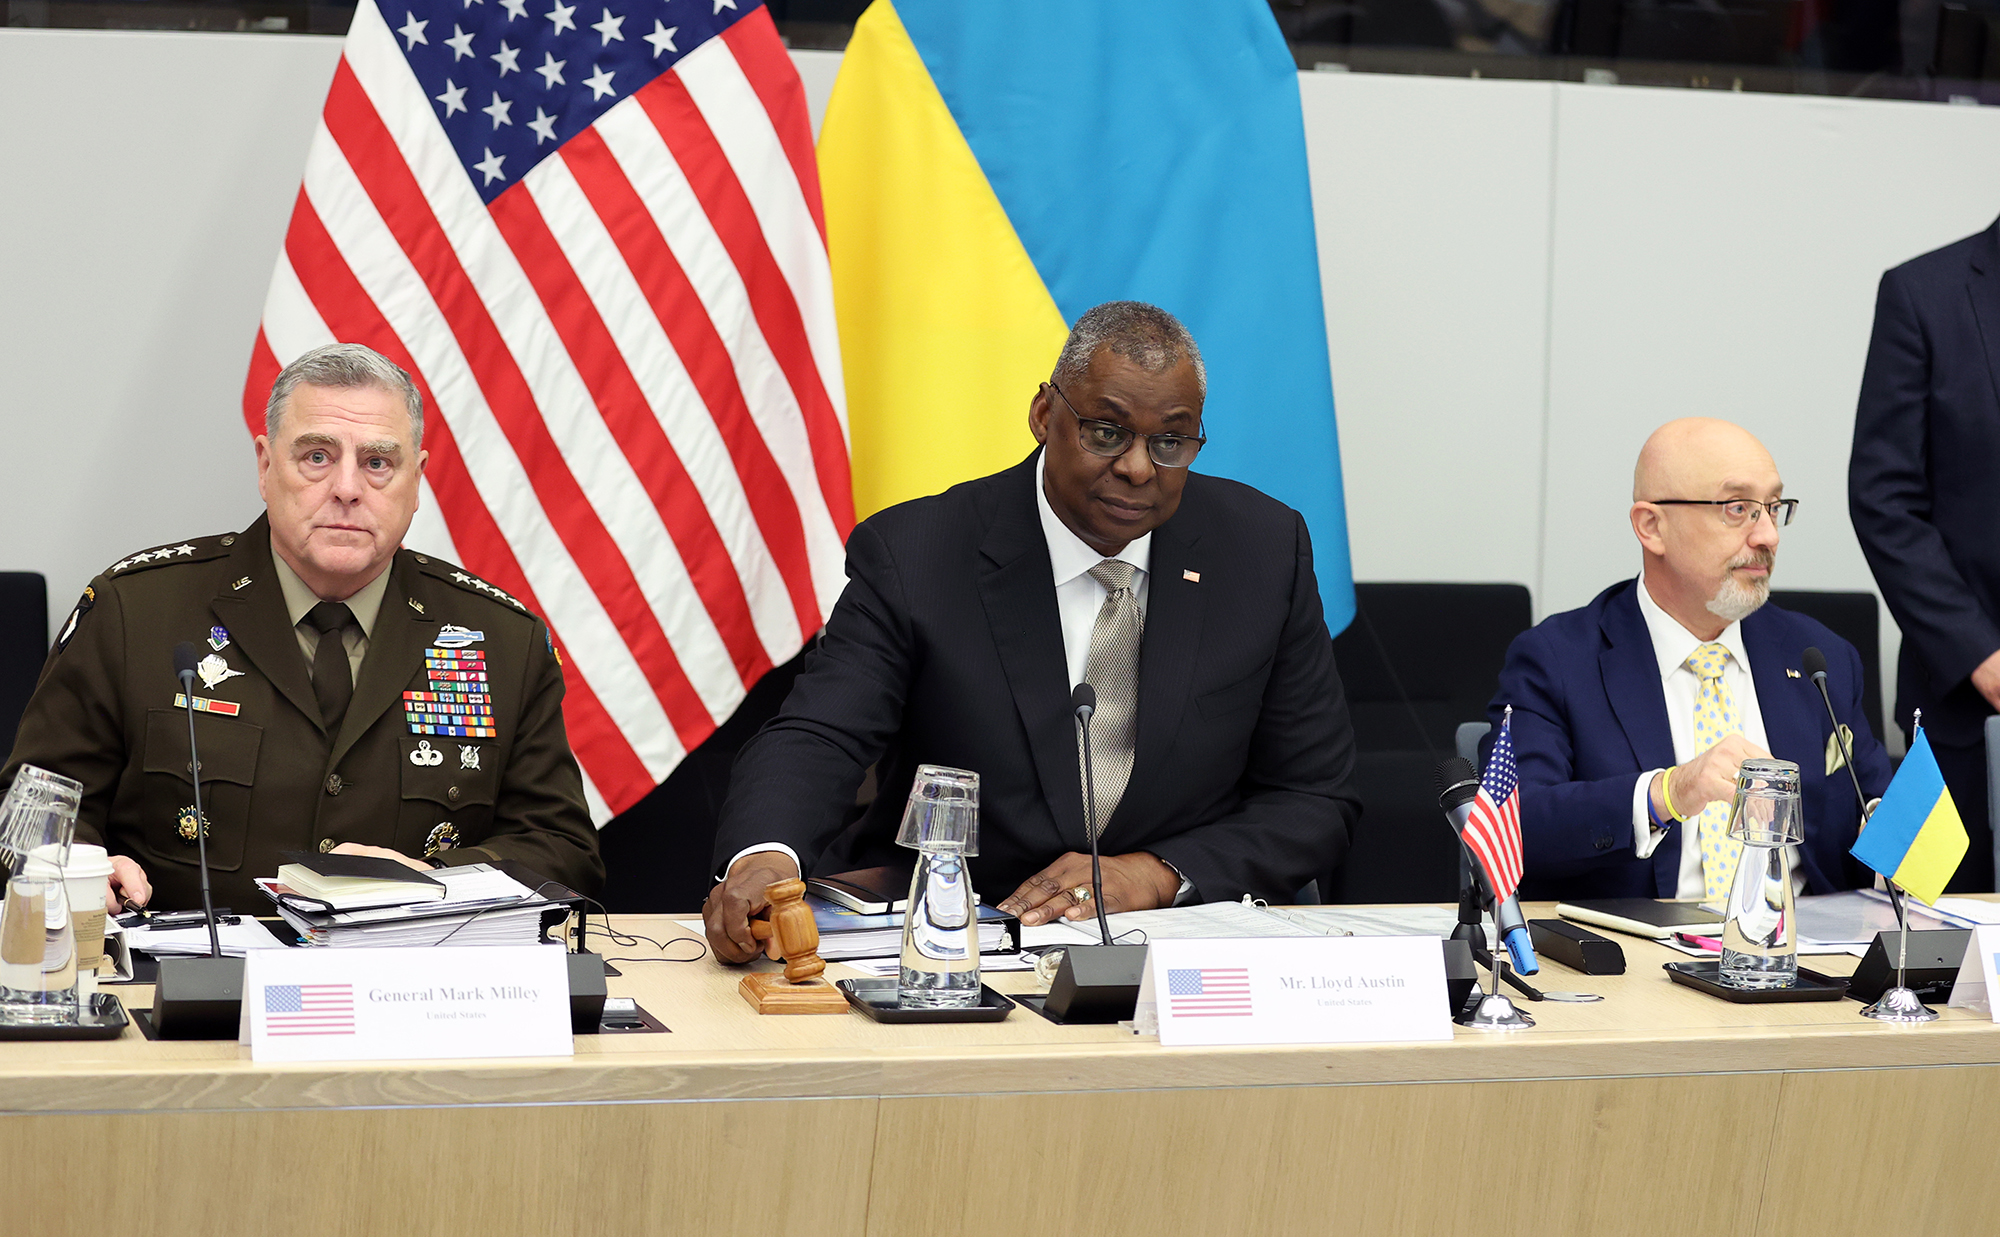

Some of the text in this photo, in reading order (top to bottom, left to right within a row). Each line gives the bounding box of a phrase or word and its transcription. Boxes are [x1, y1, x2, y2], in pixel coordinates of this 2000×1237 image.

[1279, 974, 1405, 992] Mr. Lloyd Austin
[368, 985, 540, 1003] General Mark Milley
[1316, 998, 1373, 1007] United States
[426, 1010, 487, 1020] United States
